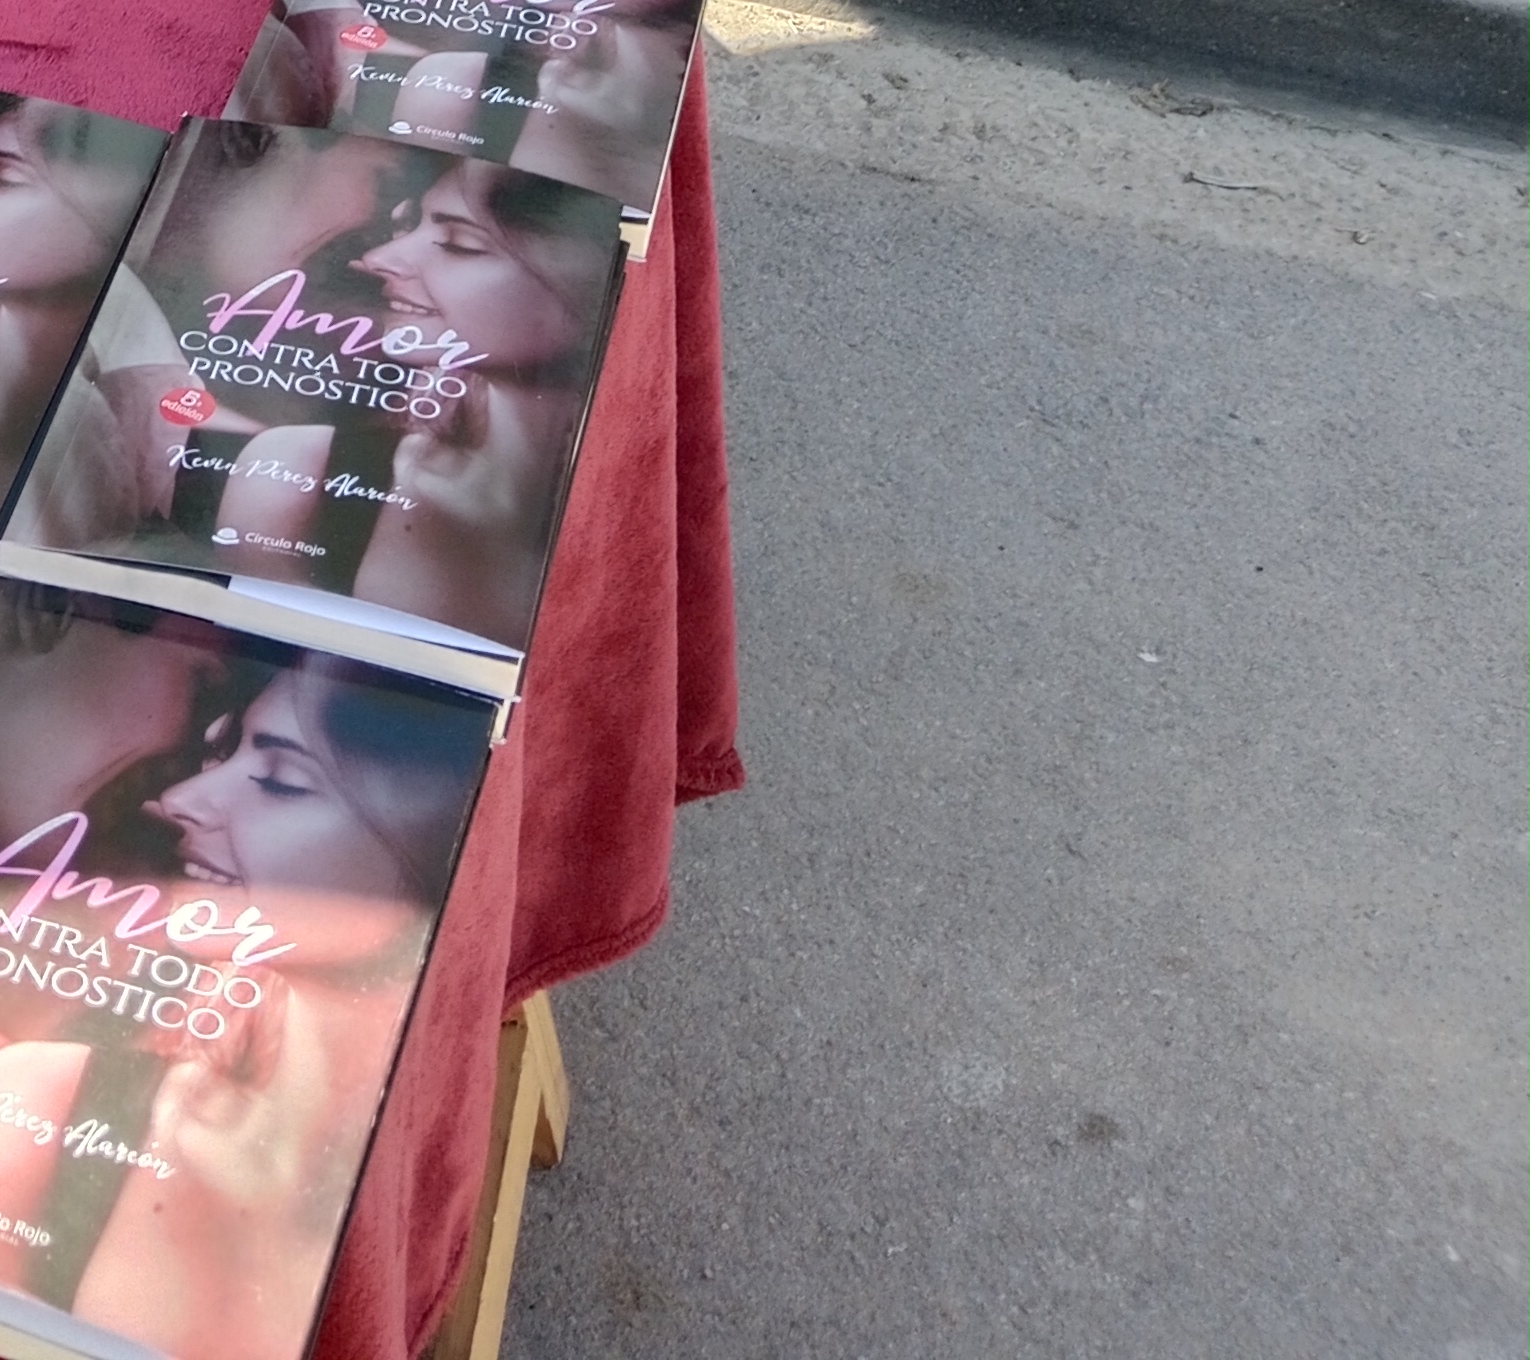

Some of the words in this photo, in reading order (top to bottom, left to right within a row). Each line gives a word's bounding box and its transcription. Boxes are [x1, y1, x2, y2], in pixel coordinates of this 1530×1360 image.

[363, 2, 577, 50] PRONÓSTICO
[500, 4, 598, 36] TODO
[202, 268, 490, 371] Amor
[179, 329, 341, 374] CONTRA
[351, 356, 468, 399] TODO
[187, 356, 442, 420] PRONÓSTICO
[166, 444, 243, 476] Kevin
[245, 458, 317, 493] Pérez
[323, 472, 419, 512] Alarcón
[244, 531, 293, 551] Círculo
[294, 539, 327, 557] Rojo
[126, 942, 262, 1009] TODO
[63, 1118, 176, 1180] Alarcón
[12, 1218, 52, 1247] Rojo
